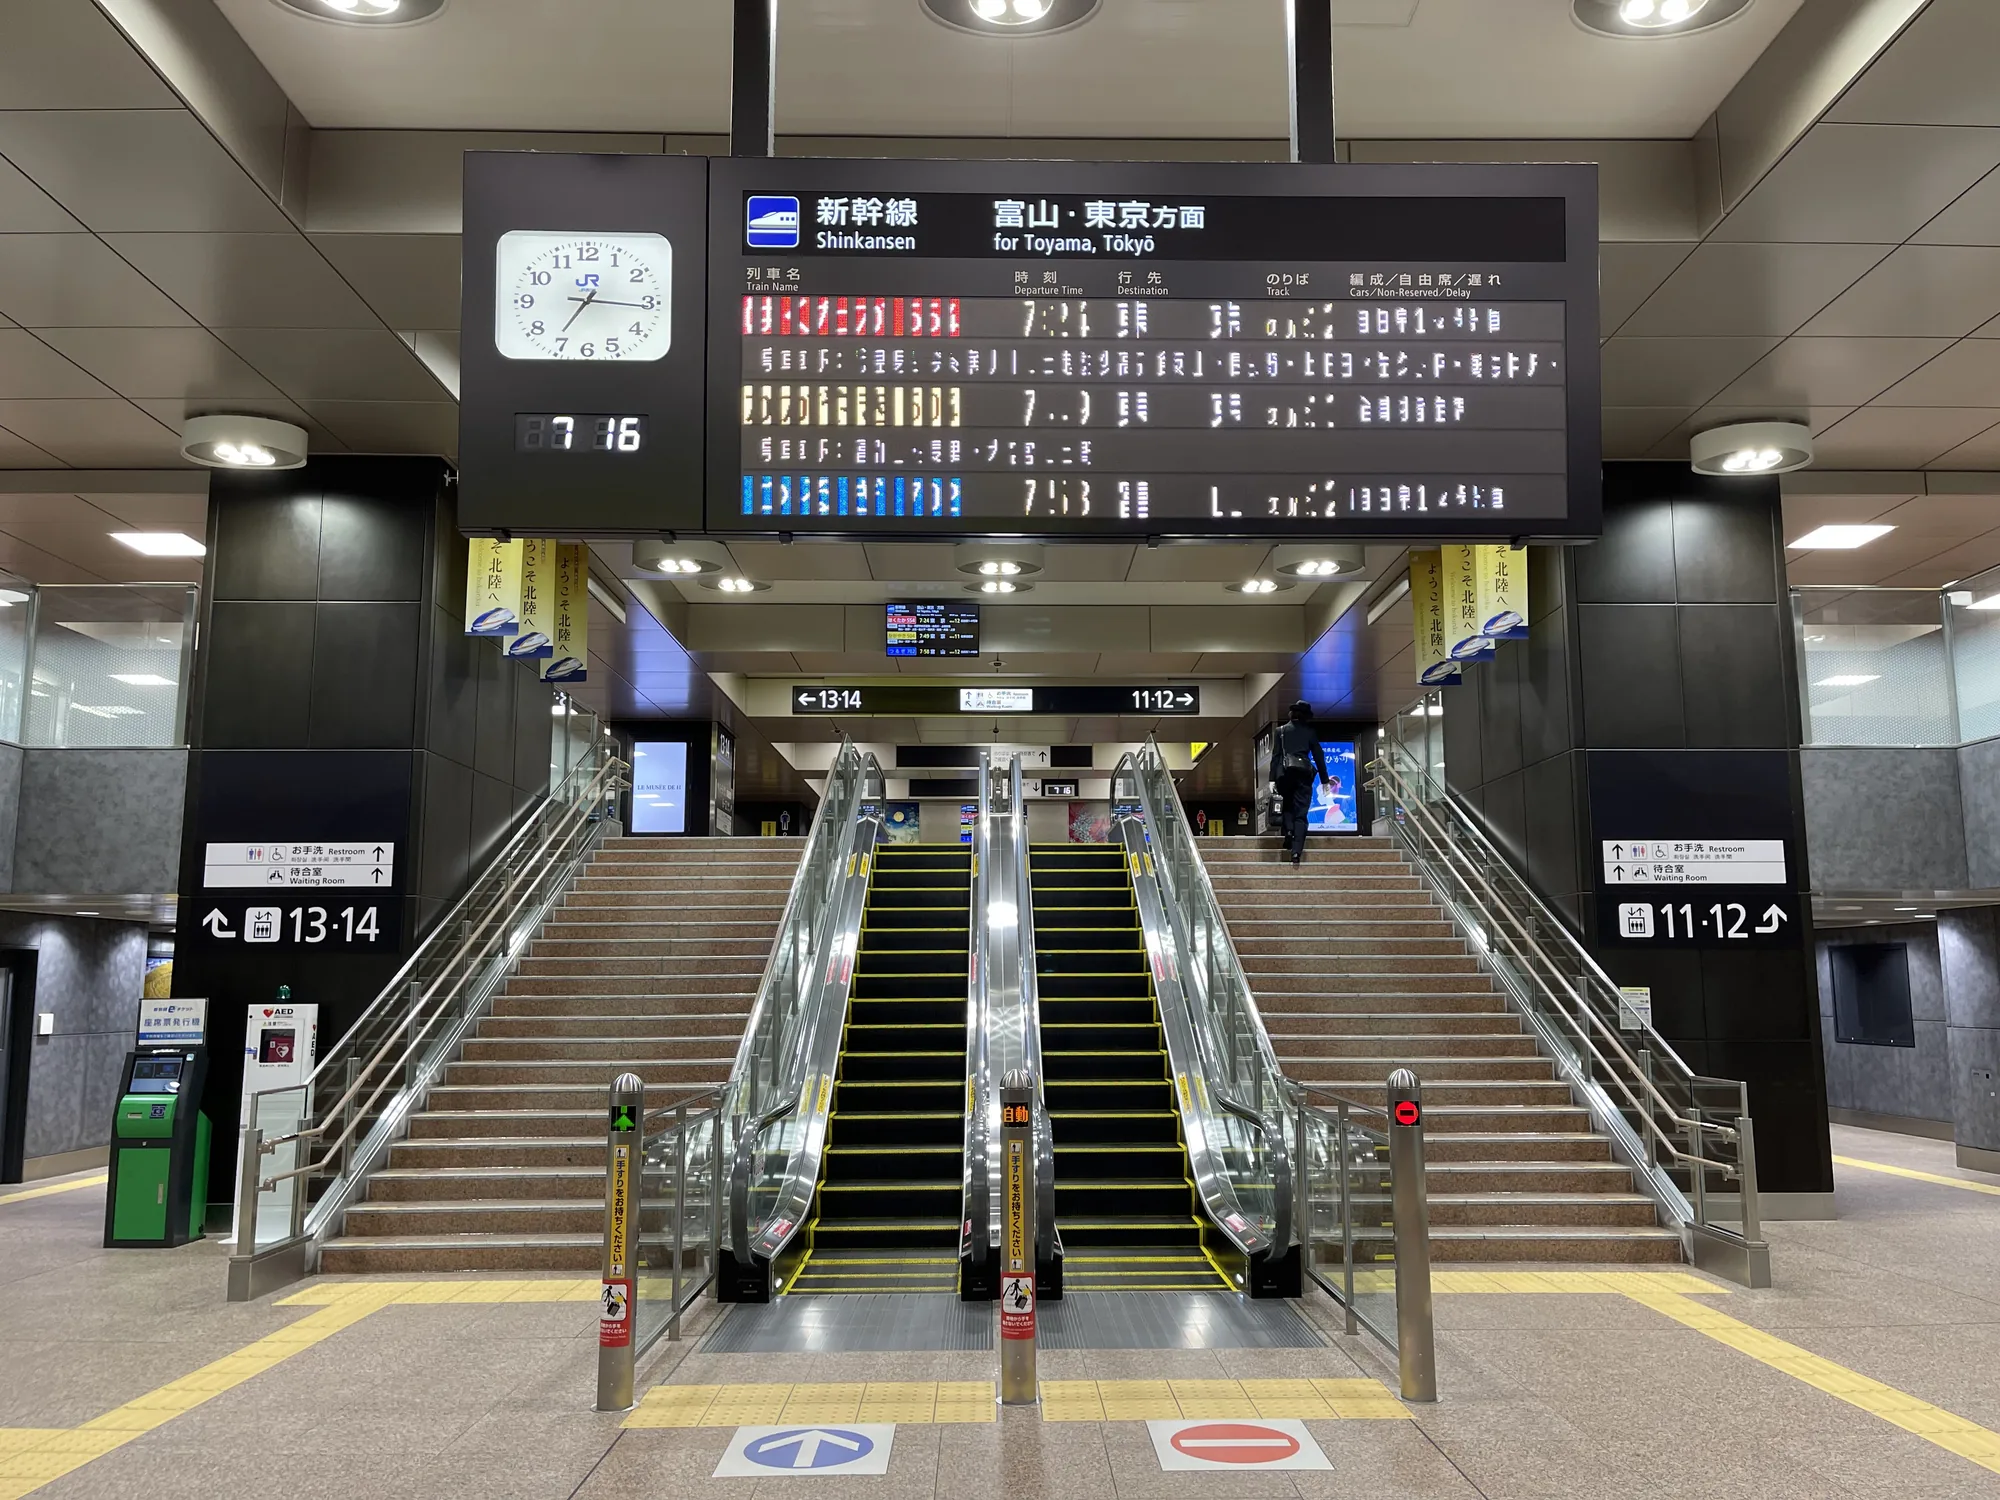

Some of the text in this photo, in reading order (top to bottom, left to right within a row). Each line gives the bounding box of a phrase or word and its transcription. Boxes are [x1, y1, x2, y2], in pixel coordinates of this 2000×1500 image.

[817, 197, 918, 227] 新幹線
[994, 199, 1206, 229] 富山・東京方面
[817, 231, 916, 250] Shinkansen
[994, 233, 1155, 256] for Toyama, Tōkyō
[577, 247, 599, 261] 12
[611, 253, 619, 268] 1
[553, 255, 572, 269] 11
[530, 271, 552, 286] 10
[576, 274, 600, 287] JR
[629, 269, 644, 283] 2
[747, 267, 800, 281] 列車名
[1266, 273, 1309, 286] のりば
[747, 282, 799, 292] Train Name
[1014, 285, 1083, 296] Departure Time
[1117, 286, 1169, 296] Destination
[1267, 287, 1290, 297] Track
[520, 294, 534, 309] 9
[641, 295, 655, 310] 3
[530, 321, 545, 336] 8
[628, 321, 643, 336] 4
[555, 338, 569, 352] 7
[580, 343, 594, 358] 6
[605, 337, 619, 352] 5
[553, 416, 640, 451] 7 16
[558, 557, 571, 652] ようこそ北陸へ
[1428, 563, 1443, 657] ようこそ北陸へ
[292, 846, 323, 855] お手洗
[1674, 843, 1745, 853] お手洗 Restroom
[290, 867, 322, 876] 待合室
[1653, 864, 1684, 873] 待合室
[290, 877, 320, 885] Waiting
[1003, 1107, 1028, 1123] 自動
[613, 1160, 625, 1262] 手すりをお持ちください
[1011, 1155, 1021, 1257] 手すりをお持ちください
